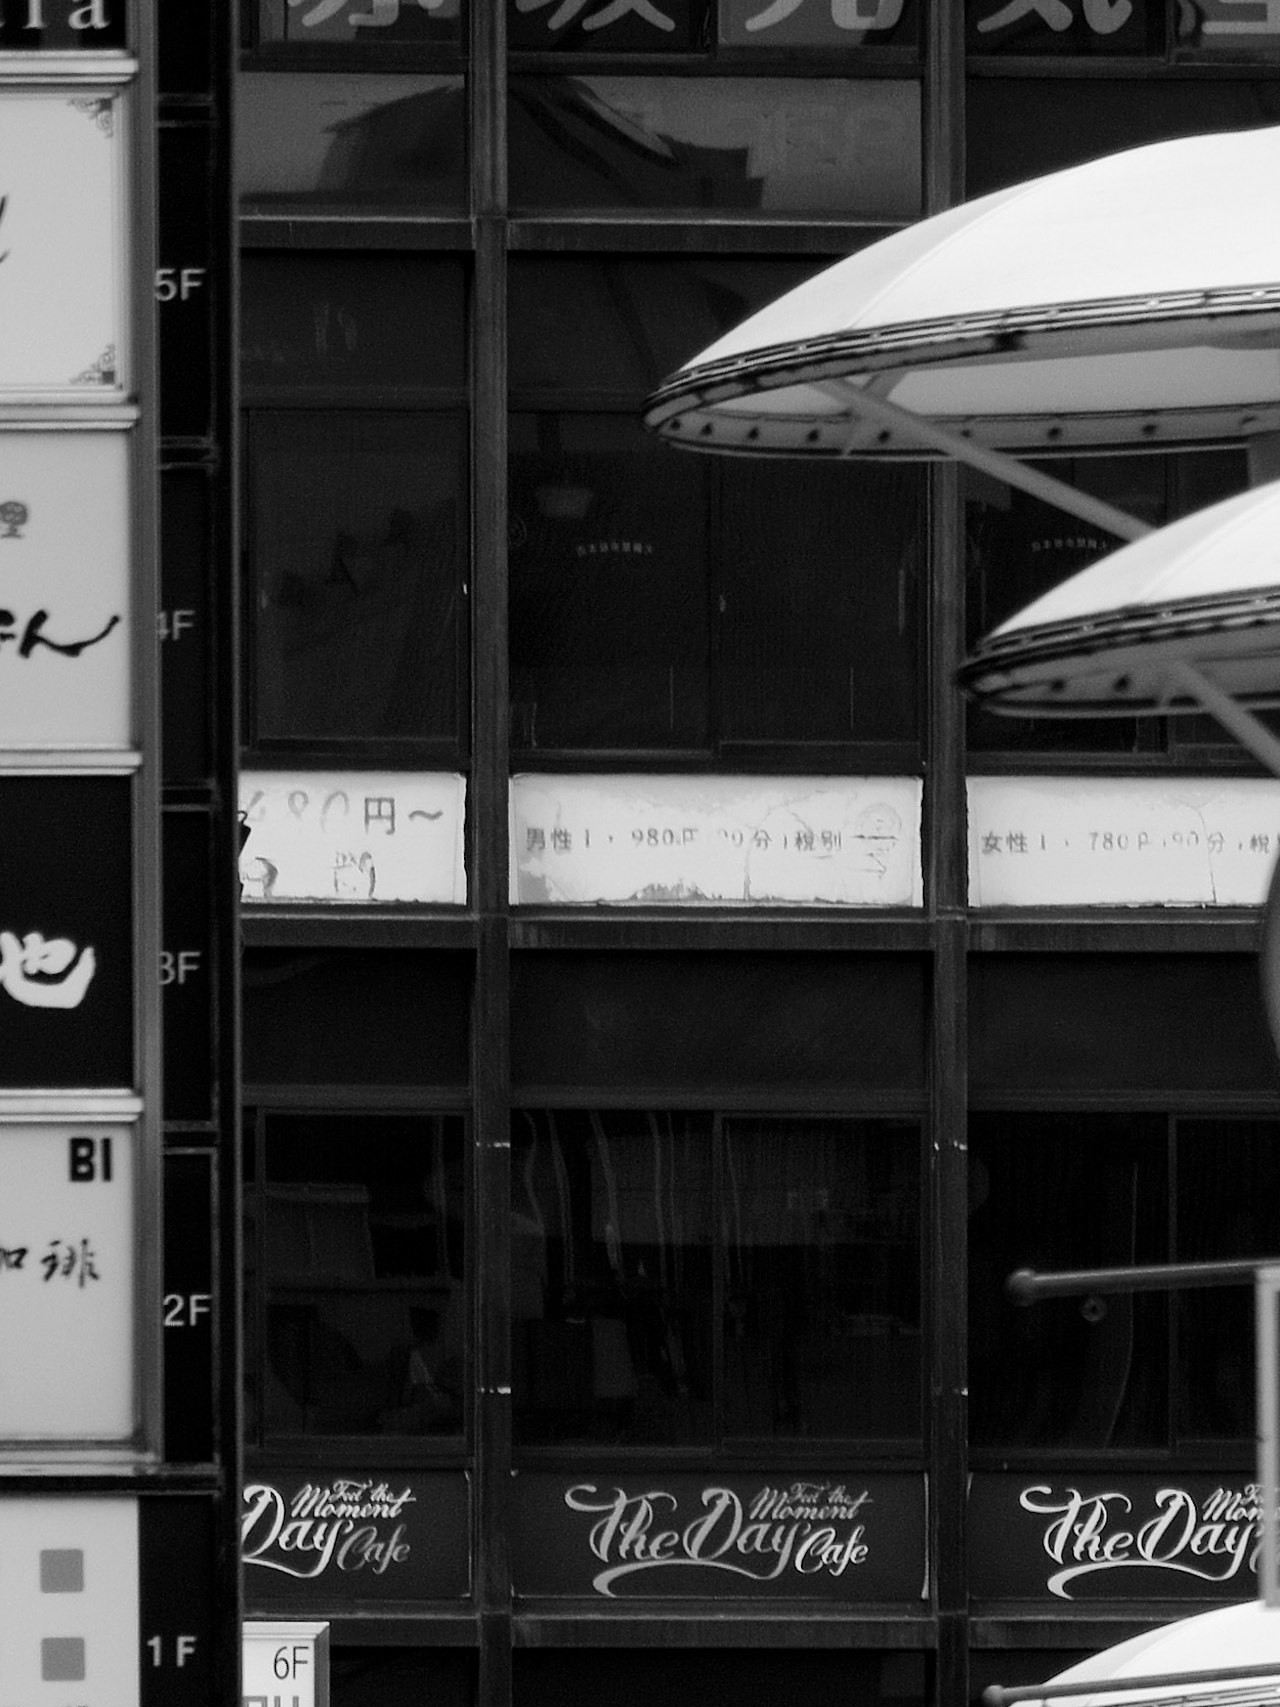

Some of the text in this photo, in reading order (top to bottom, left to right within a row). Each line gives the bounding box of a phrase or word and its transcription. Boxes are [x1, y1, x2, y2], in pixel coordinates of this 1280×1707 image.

[154, 268, 207, 301] 5F
[162, 1293, 213, 1328] 2F
[336, 1523, 410, 1575] Cafe
[564, 1483, 870, 1580] The Day Cafe
[1020, 1485, 1134, 1564] The
[1136, 1489, 1265, 1581] Day
[273, 1646, 309, 1680] 6F
